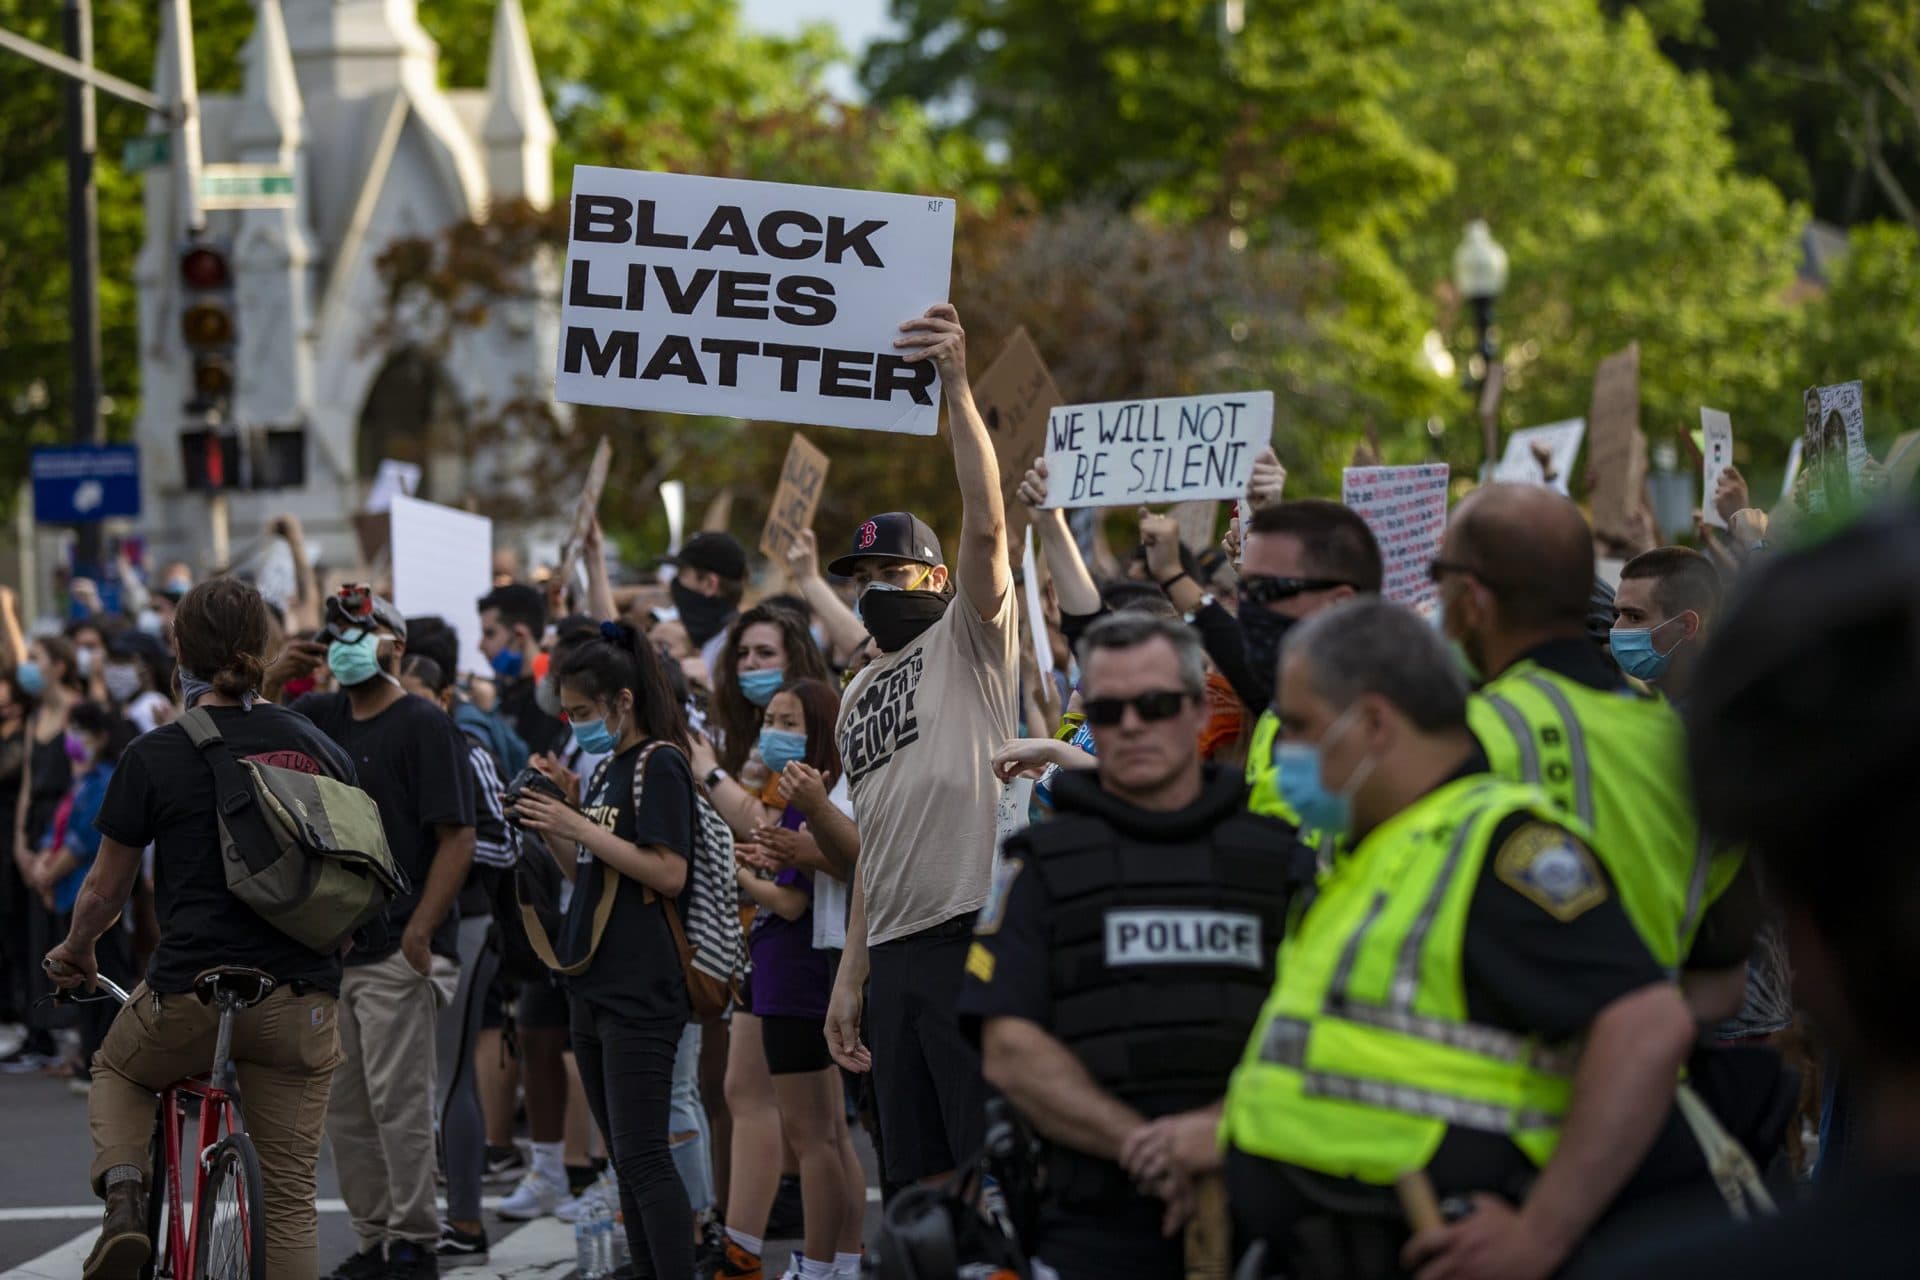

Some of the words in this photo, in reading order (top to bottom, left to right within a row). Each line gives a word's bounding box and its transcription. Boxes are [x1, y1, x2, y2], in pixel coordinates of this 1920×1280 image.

[573, 194, 888, 268] BLACK
[928, 200, 944, 212] RIP
[569, 259, 837, 326] LIVES
[563, 326, 937, 406] MATTER
[1052, 413, 1084, 452] WE
[1099, 404, 1165, 444] WILL
[1178, 402, 1246, 443] NOT
[1070, 453, 1108, 500] BE
[1127, 441, 1246, 495] SILENT.
[859, 520, 877, 549] B
[910, 657, 923, 676] TO
[1118, 919, 1254, 954] POLICE
